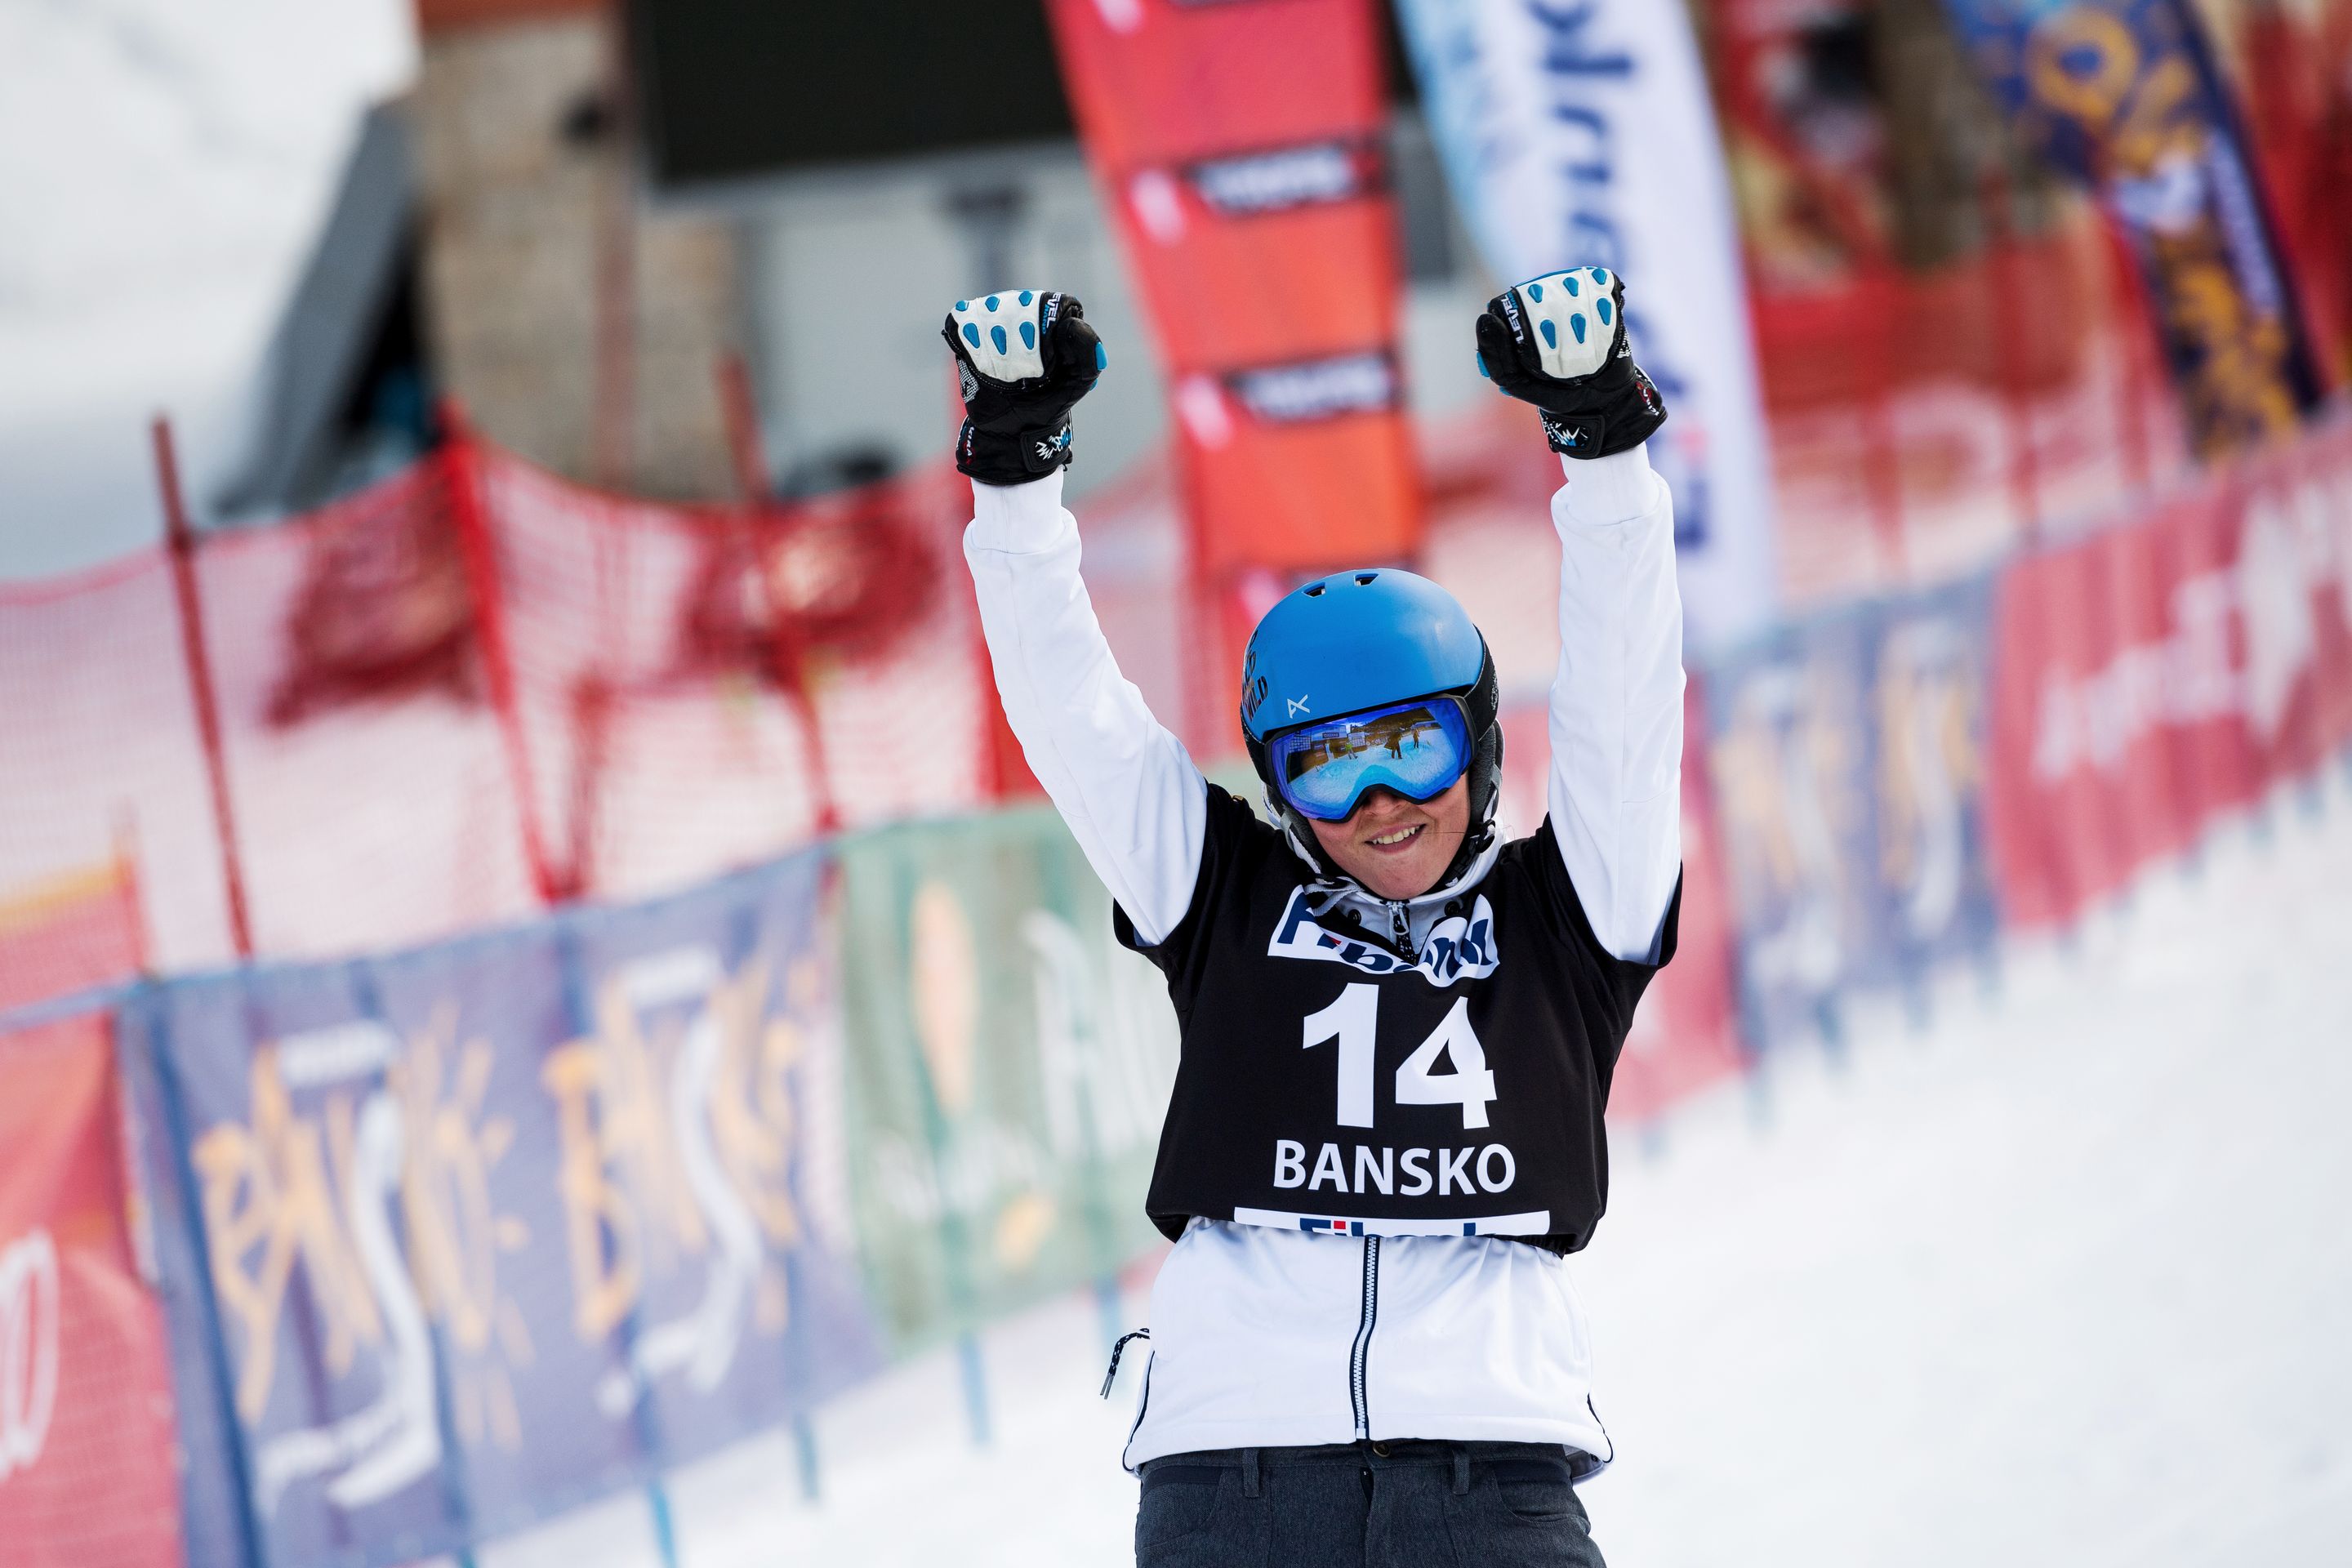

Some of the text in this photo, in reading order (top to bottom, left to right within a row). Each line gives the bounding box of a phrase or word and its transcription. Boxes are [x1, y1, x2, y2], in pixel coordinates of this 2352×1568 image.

[1047, 292, 1064, 328] EVEL
[1501, 294, 1525, 341] LEVEL
[1302, 982, 1498, 1129] 14
[1273, 1139, 1516, 1196] BANSKO
